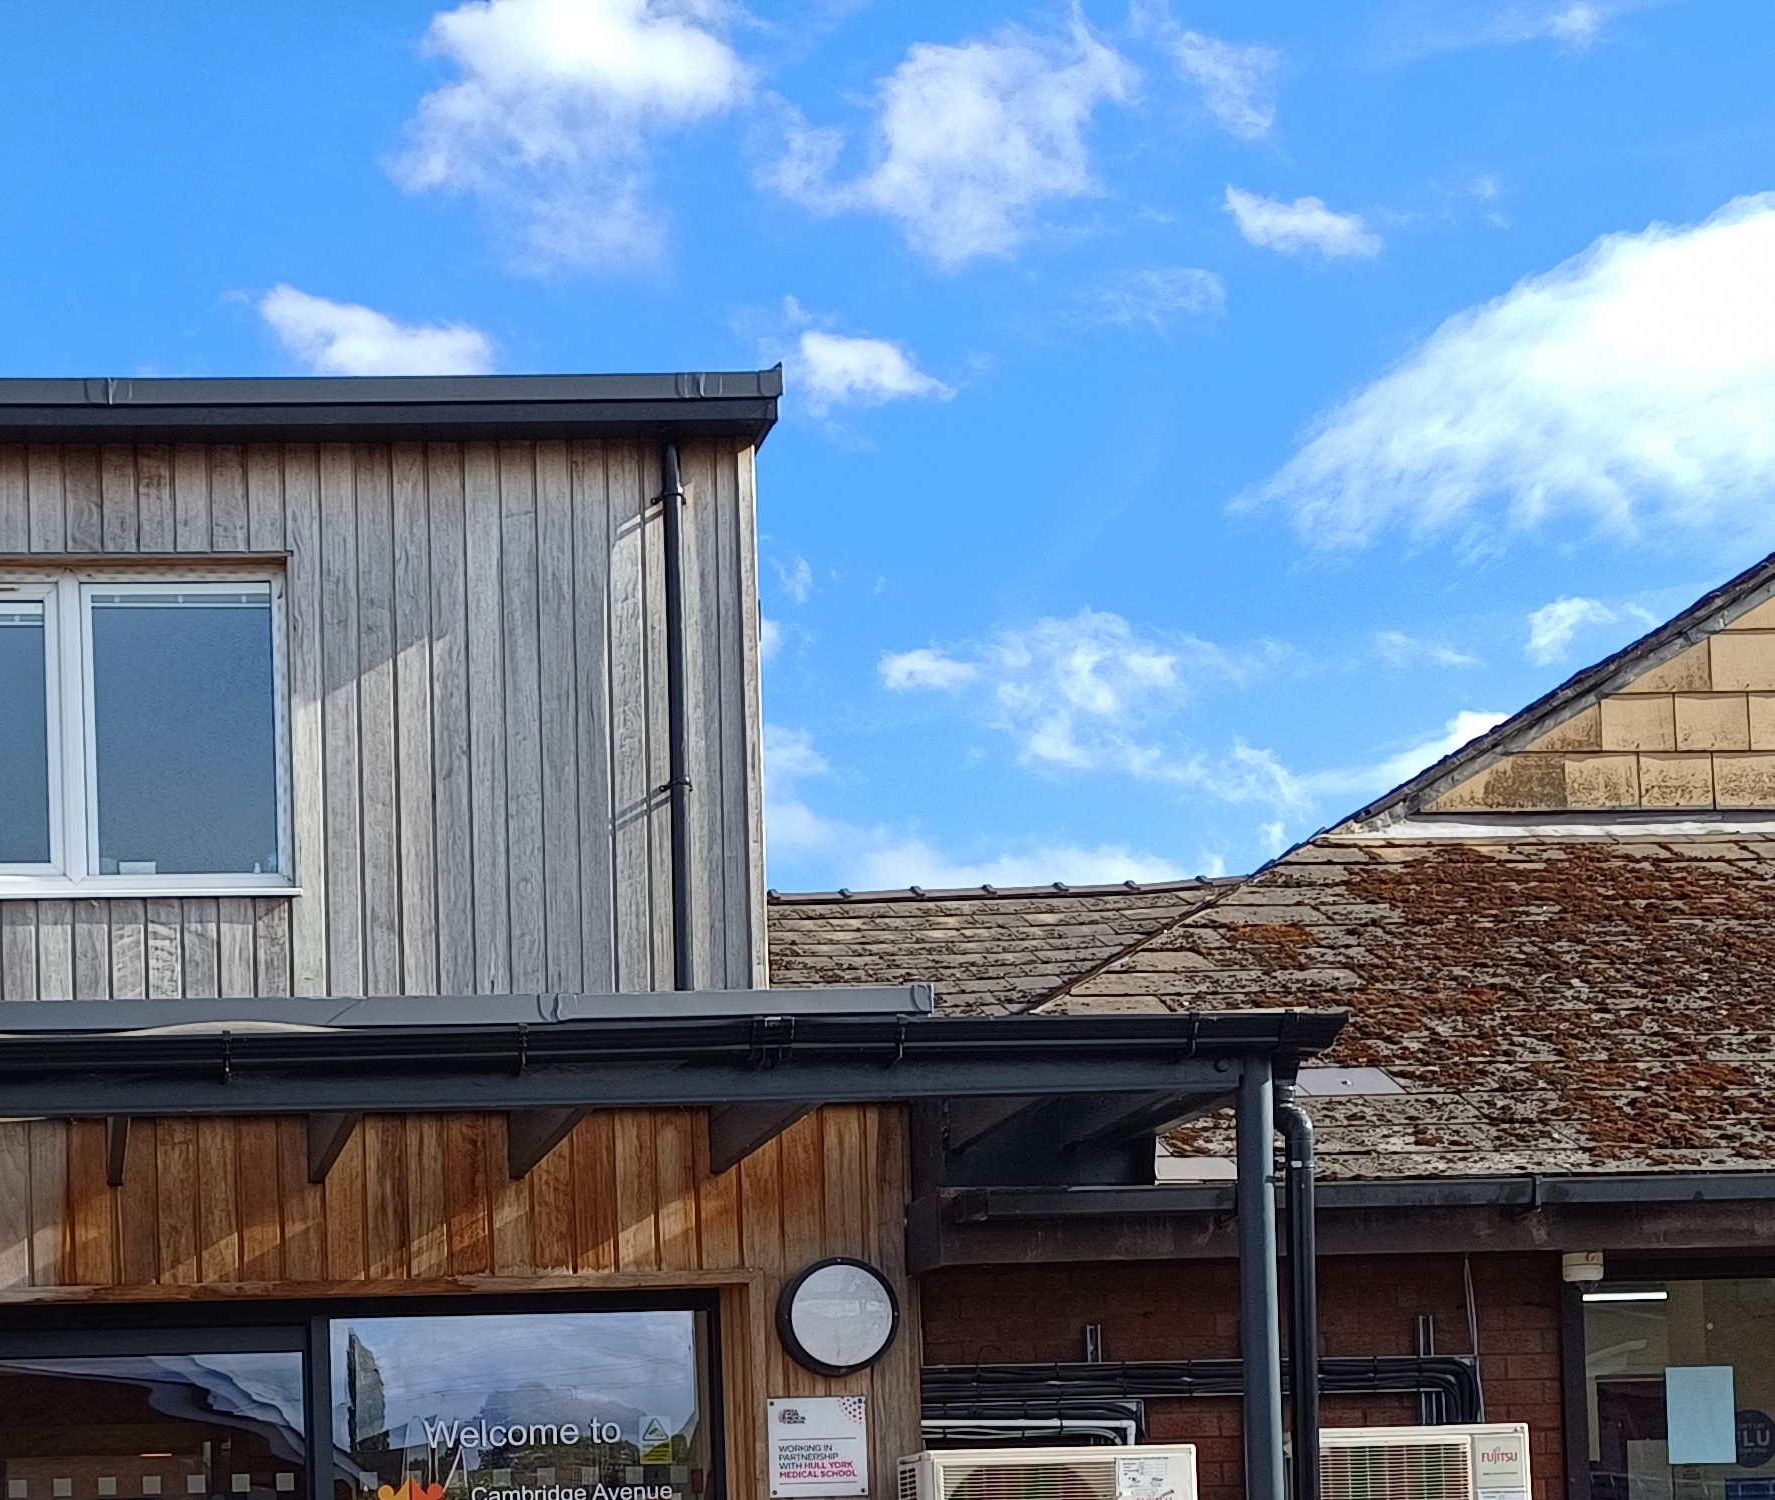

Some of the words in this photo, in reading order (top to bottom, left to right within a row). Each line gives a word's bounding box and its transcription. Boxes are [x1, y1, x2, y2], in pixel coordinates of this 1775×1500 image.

[425, 1419, 579, 1448] Welcome
[590, 1417, 622, 1444] to
[778, 1444, 821, 1452] WORKING
[823, 1444, 833, 1452] IN
[779, 1453, 839, 1461] PARTNERSHIP
[1481, 1451, 1518, 1464] FUJITSU
[779, 1462, 802, 1470] WITH
[820, 1469, 858, 1477] SCHOOL
[592, 1483, 673, 1500] Avenue
